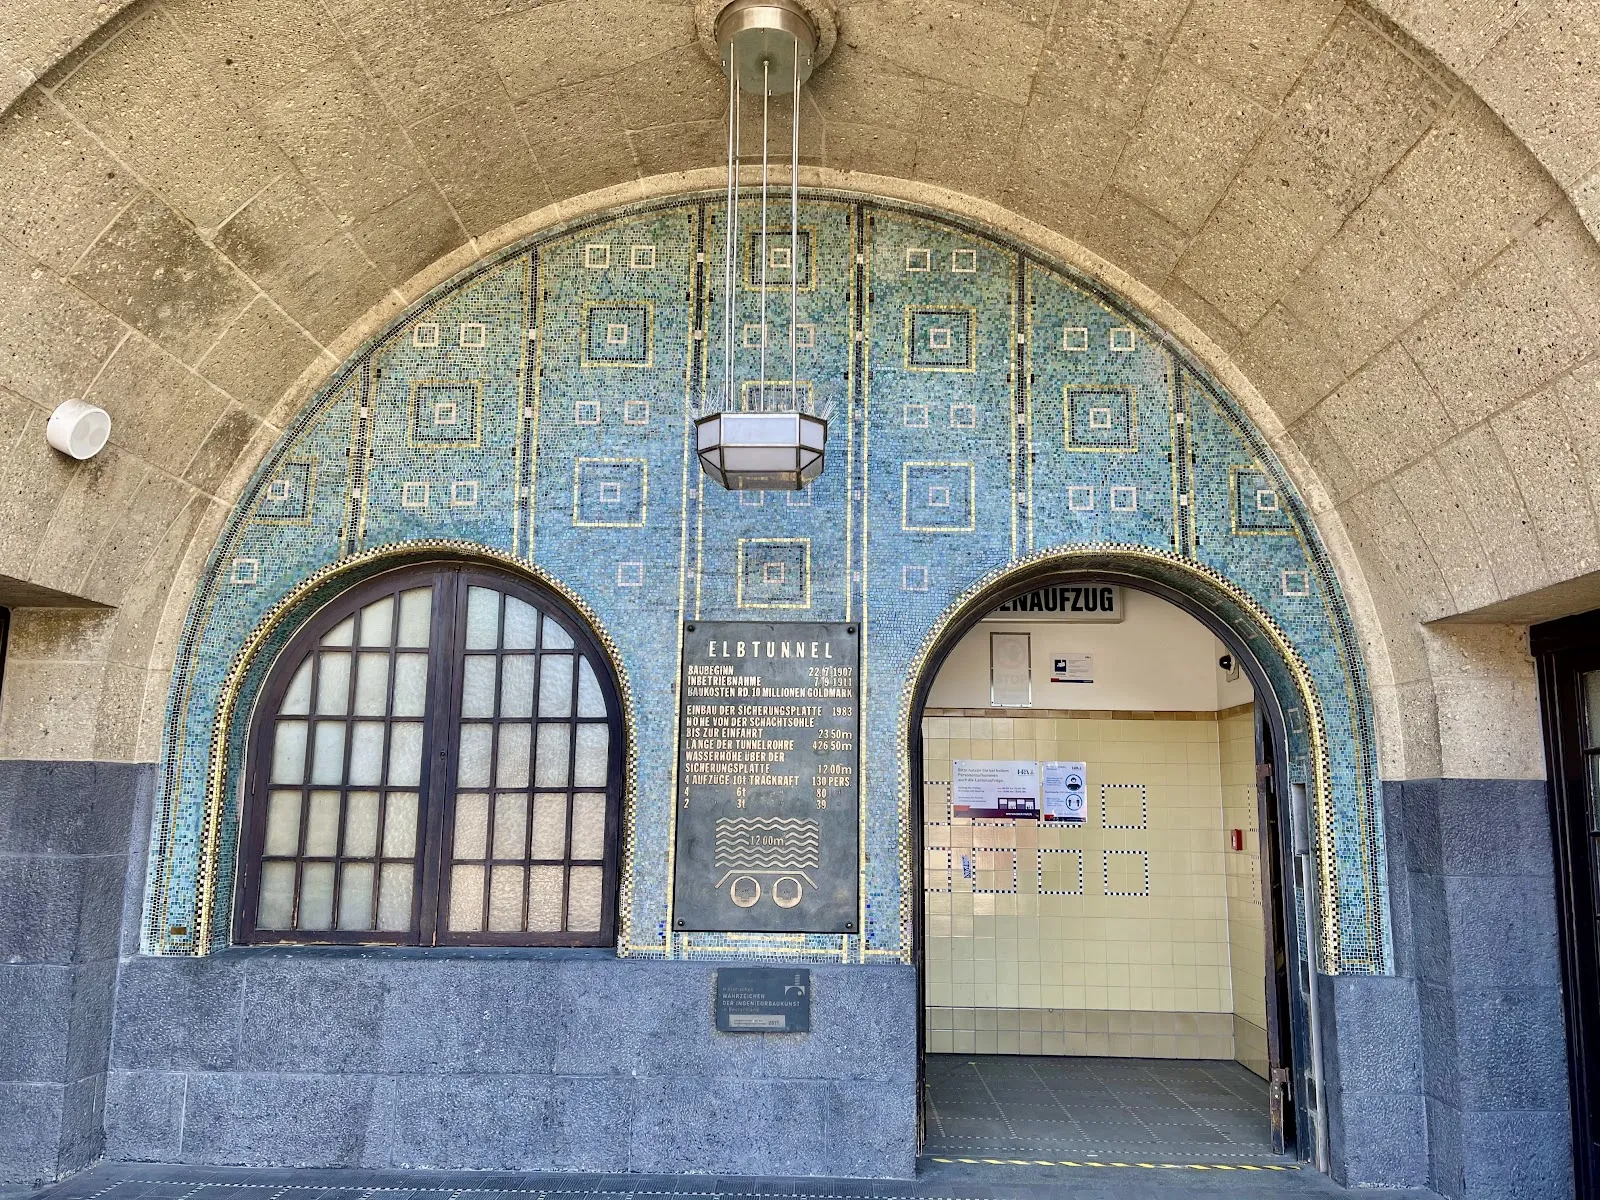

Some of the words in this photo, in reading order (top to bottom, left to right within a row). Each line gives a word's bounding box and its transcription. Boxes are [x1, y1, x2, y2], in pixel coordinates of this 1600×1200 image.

[708, 640, 832, 658] ELBTUNNEL
[688, 666, 734, 675] BAUBEGINN
[688, 676, 761, 686] INBETRIEBNAHME
[688, 687, 735, 697] BAUKOSTEN
[737, 688, 750, 697] RD.
[752, 688, 760, 697] 10
[762, 688, 805, 698] MILLIONEN
[808, 688, 852, 698] GOLDMARK
[686, 706, 717, 715] EINBAU
[719, 706, 735, 715] DER
[738, 706, 822, 716] SICHERUNGSPLATTE
[832, 707, 852, 716] 1983
[713, 717, 728, 726] VON
[731, 717, 747, 727] DER
[750, 718, 814, 727] SCHACHTSOHLE
[686, 728, 700, 737] BIS
[702, 728, 719, 737] ZUR
[722, 728, 763, 738] EINFAHRT
[717, 740, 732, 749] DER
[686, 750, 742, 761] WASSERHÖHE
[745, 751, 766, 761] ÜBER
[768, 752, 785, 762] DER
[685, 763, 770, 773] SICHERUNGSPLATTE
[684, 776, 689, 785] 4
[693, 775, 730, 785] AUFZÜGE
[732, 775, 747, 785] 10t
[749, 775, 799, 785] TRAGKRAFT
[812, 776, 826, 786] 130
[829, 776, 851, 786] PERS.
[684, 787, 689, 796] 4
[737, 787, 746, 797] 6t
[816, 788, 826, 798] 80
[684, 799, 689, 808] 2
[737, 799, 746, 808] 3t
[816, 800, 826, 809] 39
